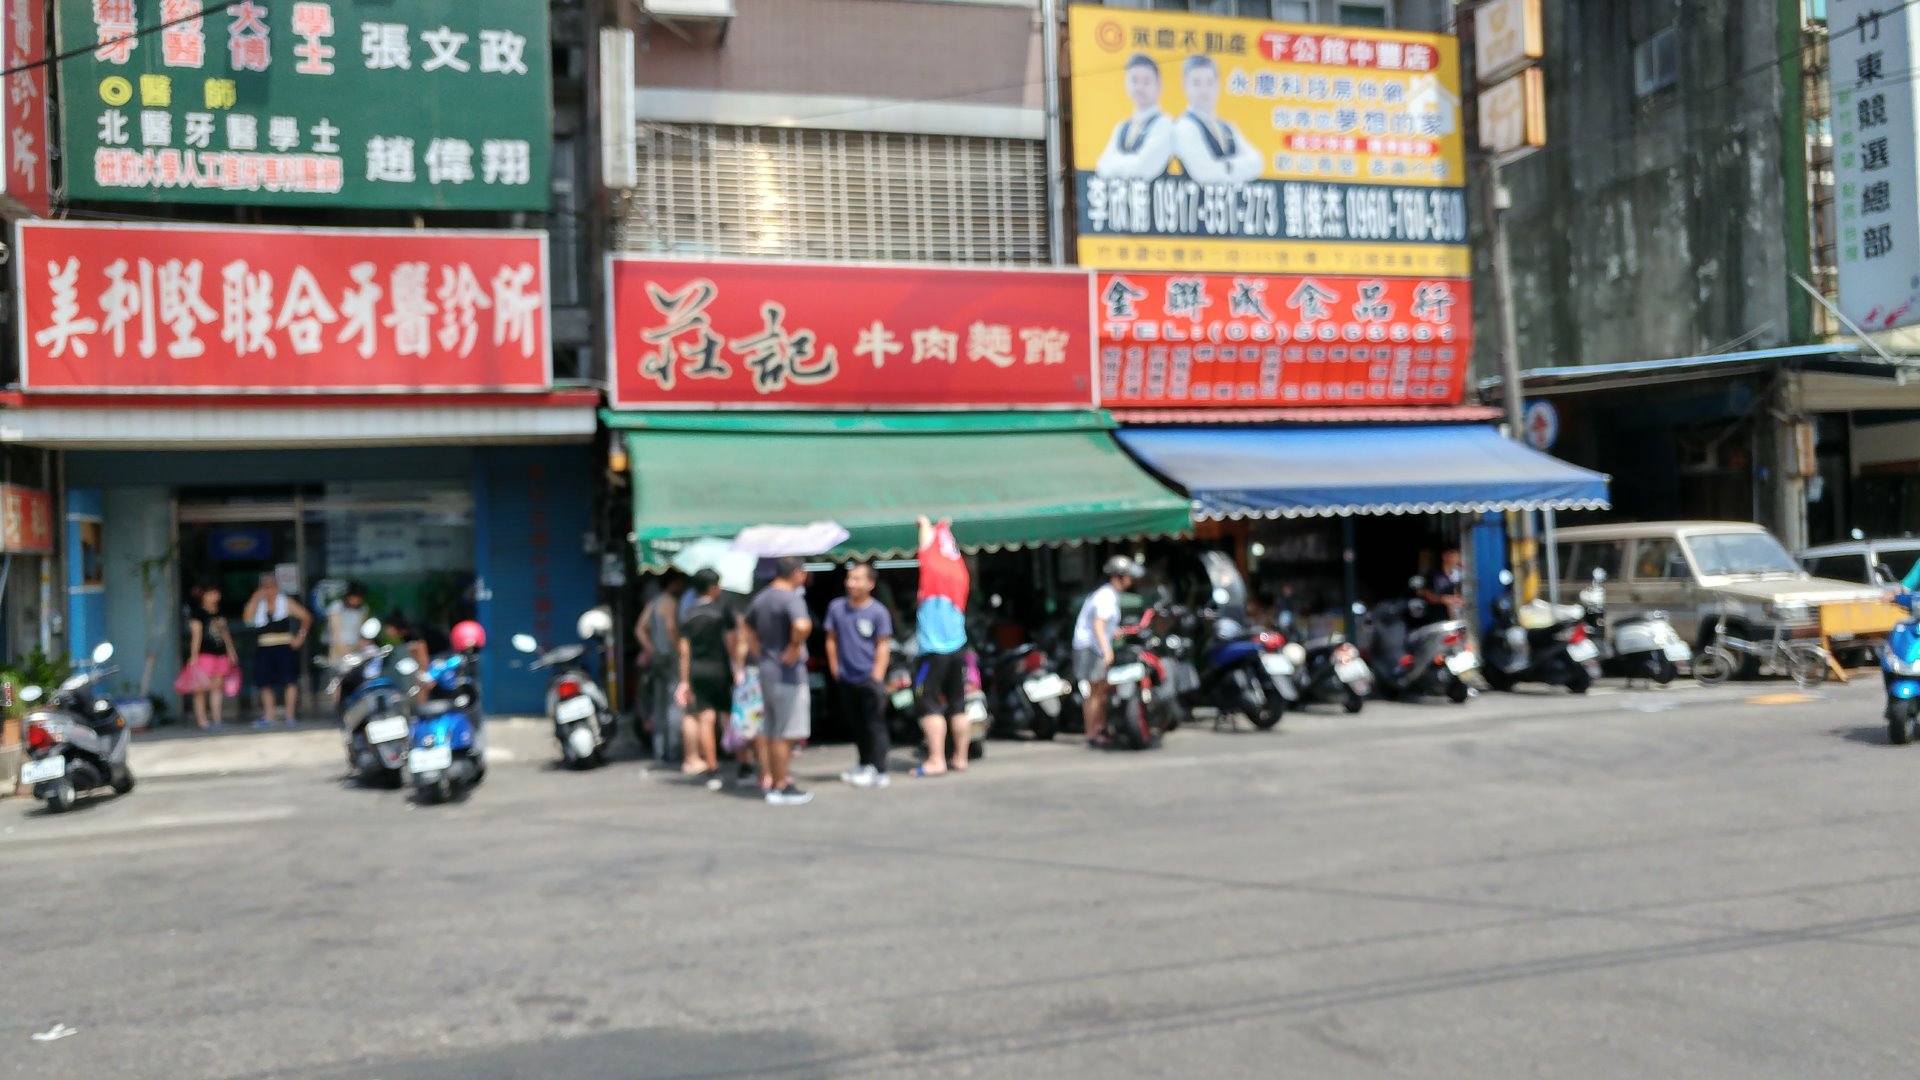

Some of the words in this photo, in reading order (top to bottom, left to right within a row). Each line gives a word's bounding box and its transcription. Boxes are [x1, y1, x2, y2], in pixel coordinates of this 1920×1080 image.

[360, 21, 529, 76] 張文政
[139, 73, 238, 110] 醫師
[97, 110, 341, 153] 北醫牙醫學士
[366, 133, 531, 185] 趙偉翔
[1855, 9, 1893, 261] 竹東競選總部
[1153, 179, 1279, 236] 0917-551-273
[35, 256, 541, 361] 美利堅聯合牙醫診所
[638, 278, 839, 394] 莊記
[852, 320, 1072, 368] 牛肉麵館
